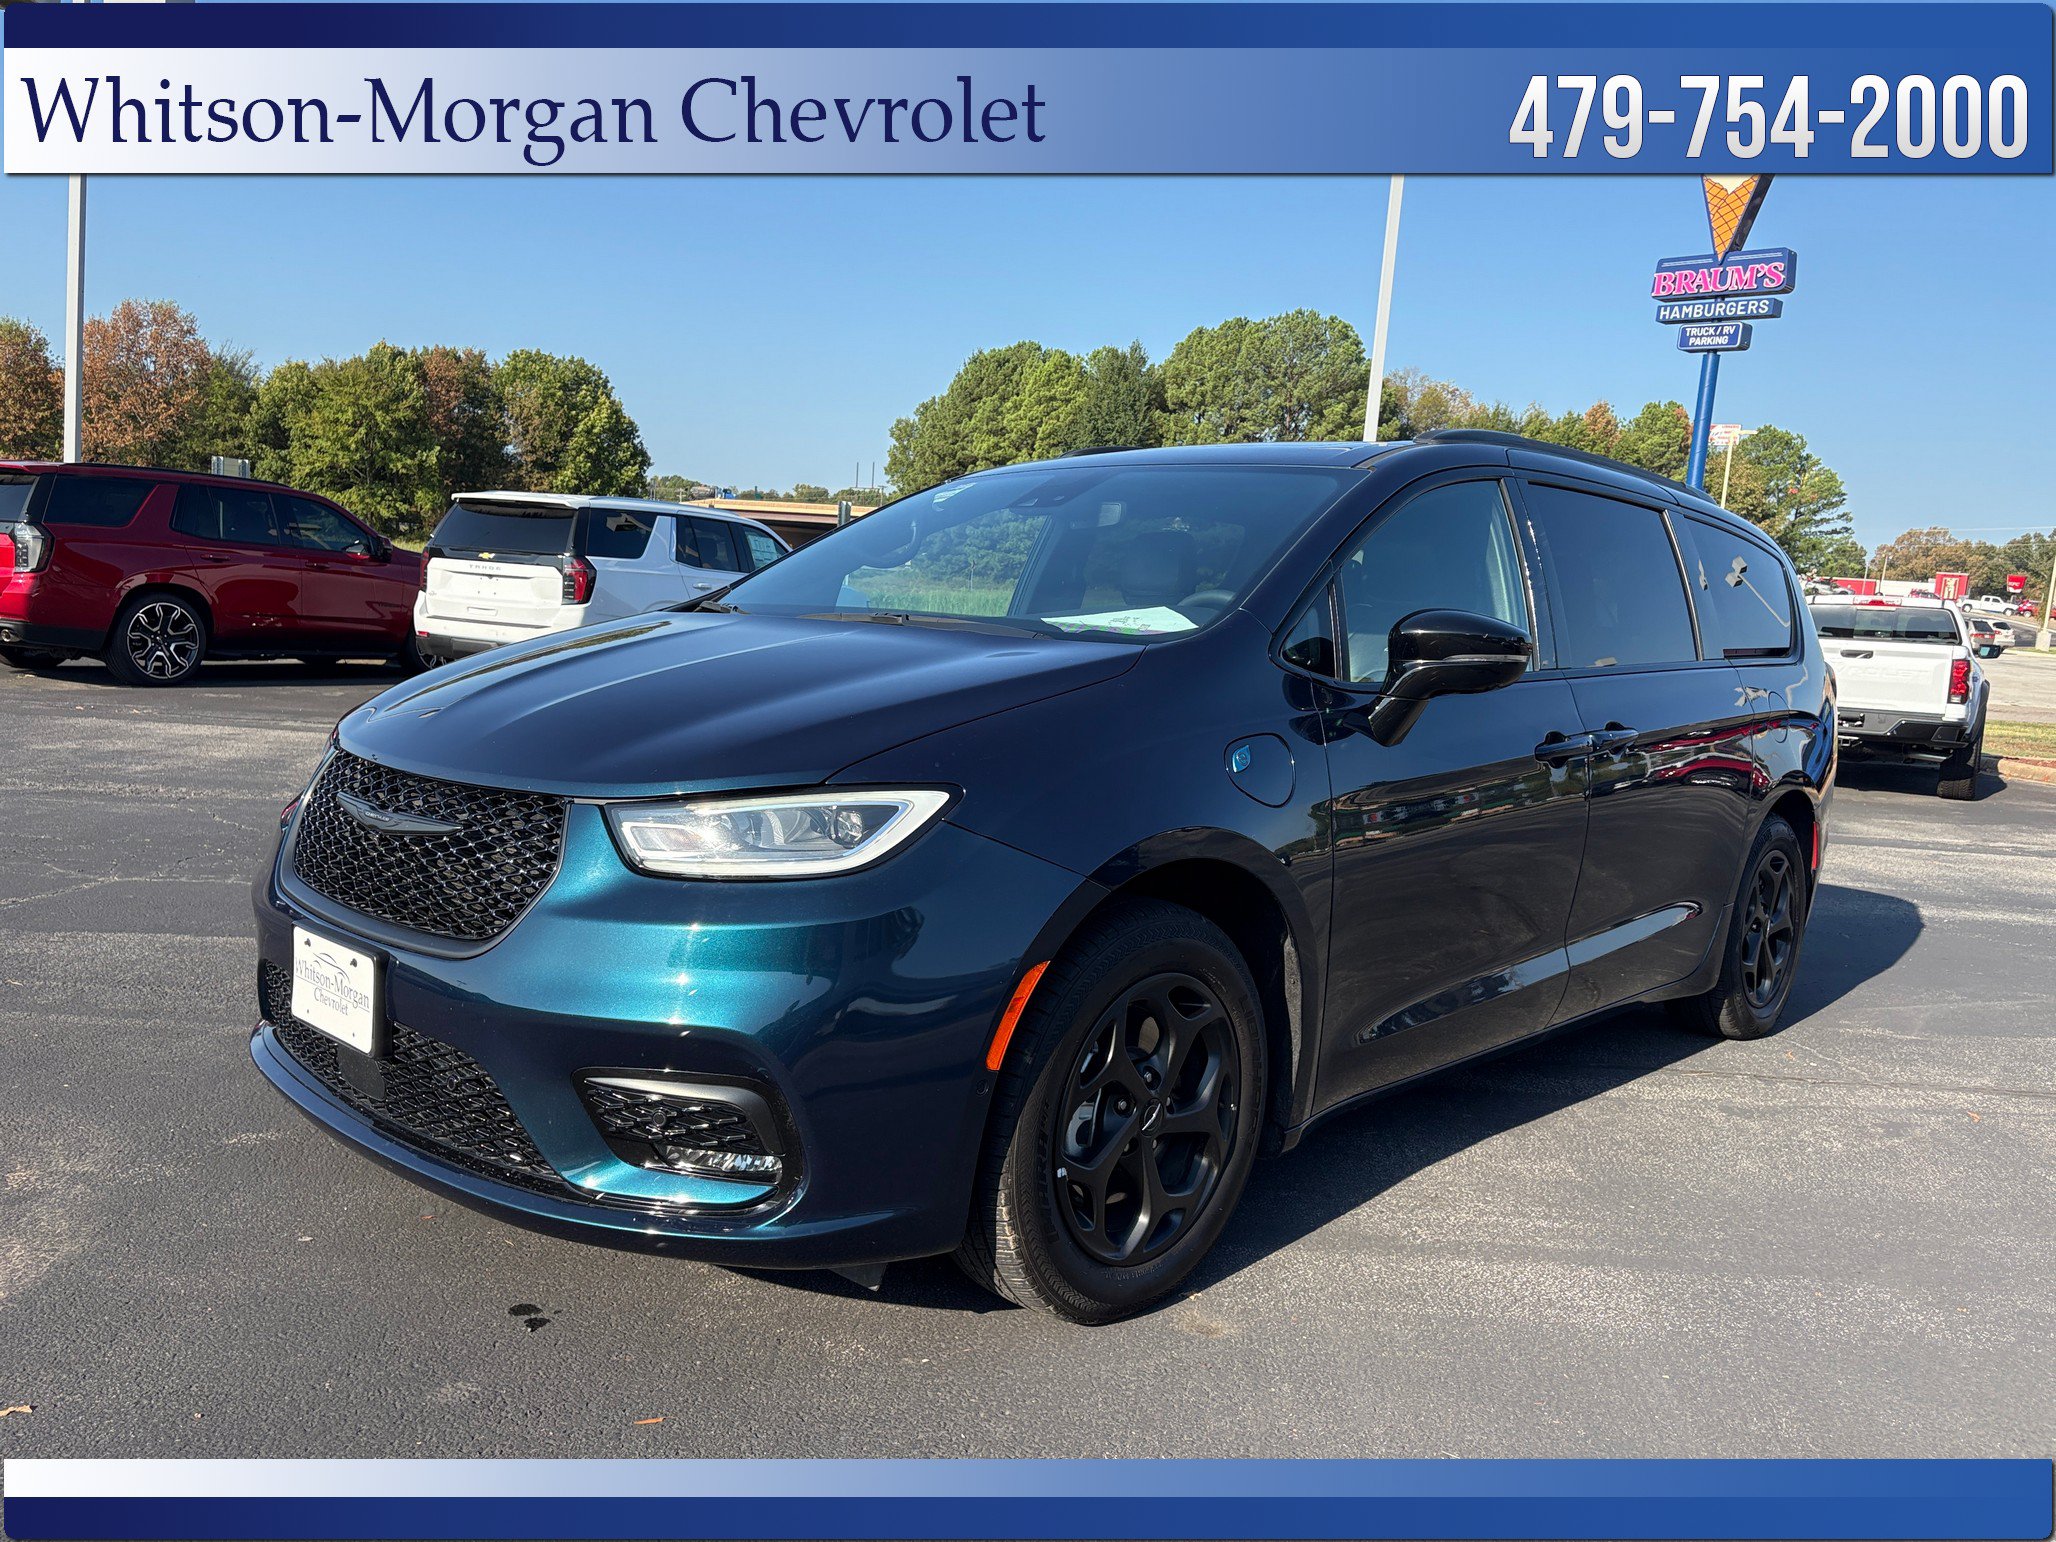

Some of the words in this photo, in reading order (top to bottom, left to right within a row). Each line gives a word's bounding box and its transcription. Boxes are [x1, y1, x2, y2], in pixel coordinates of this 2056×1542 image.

[1651, 262, 1786, 297] BRAUM'S
[1659, 299, 1770, 320] HAMBURGERS
[1685, 326, 1716, 337] TRUCK
[1722, 325, 1737, 335] RV
[1688, 335, 1729, 347] PARKING
[295, 956, 370, 1009] Whitson-Morgan
[313, 986, 349, 1016] Chevrolet
